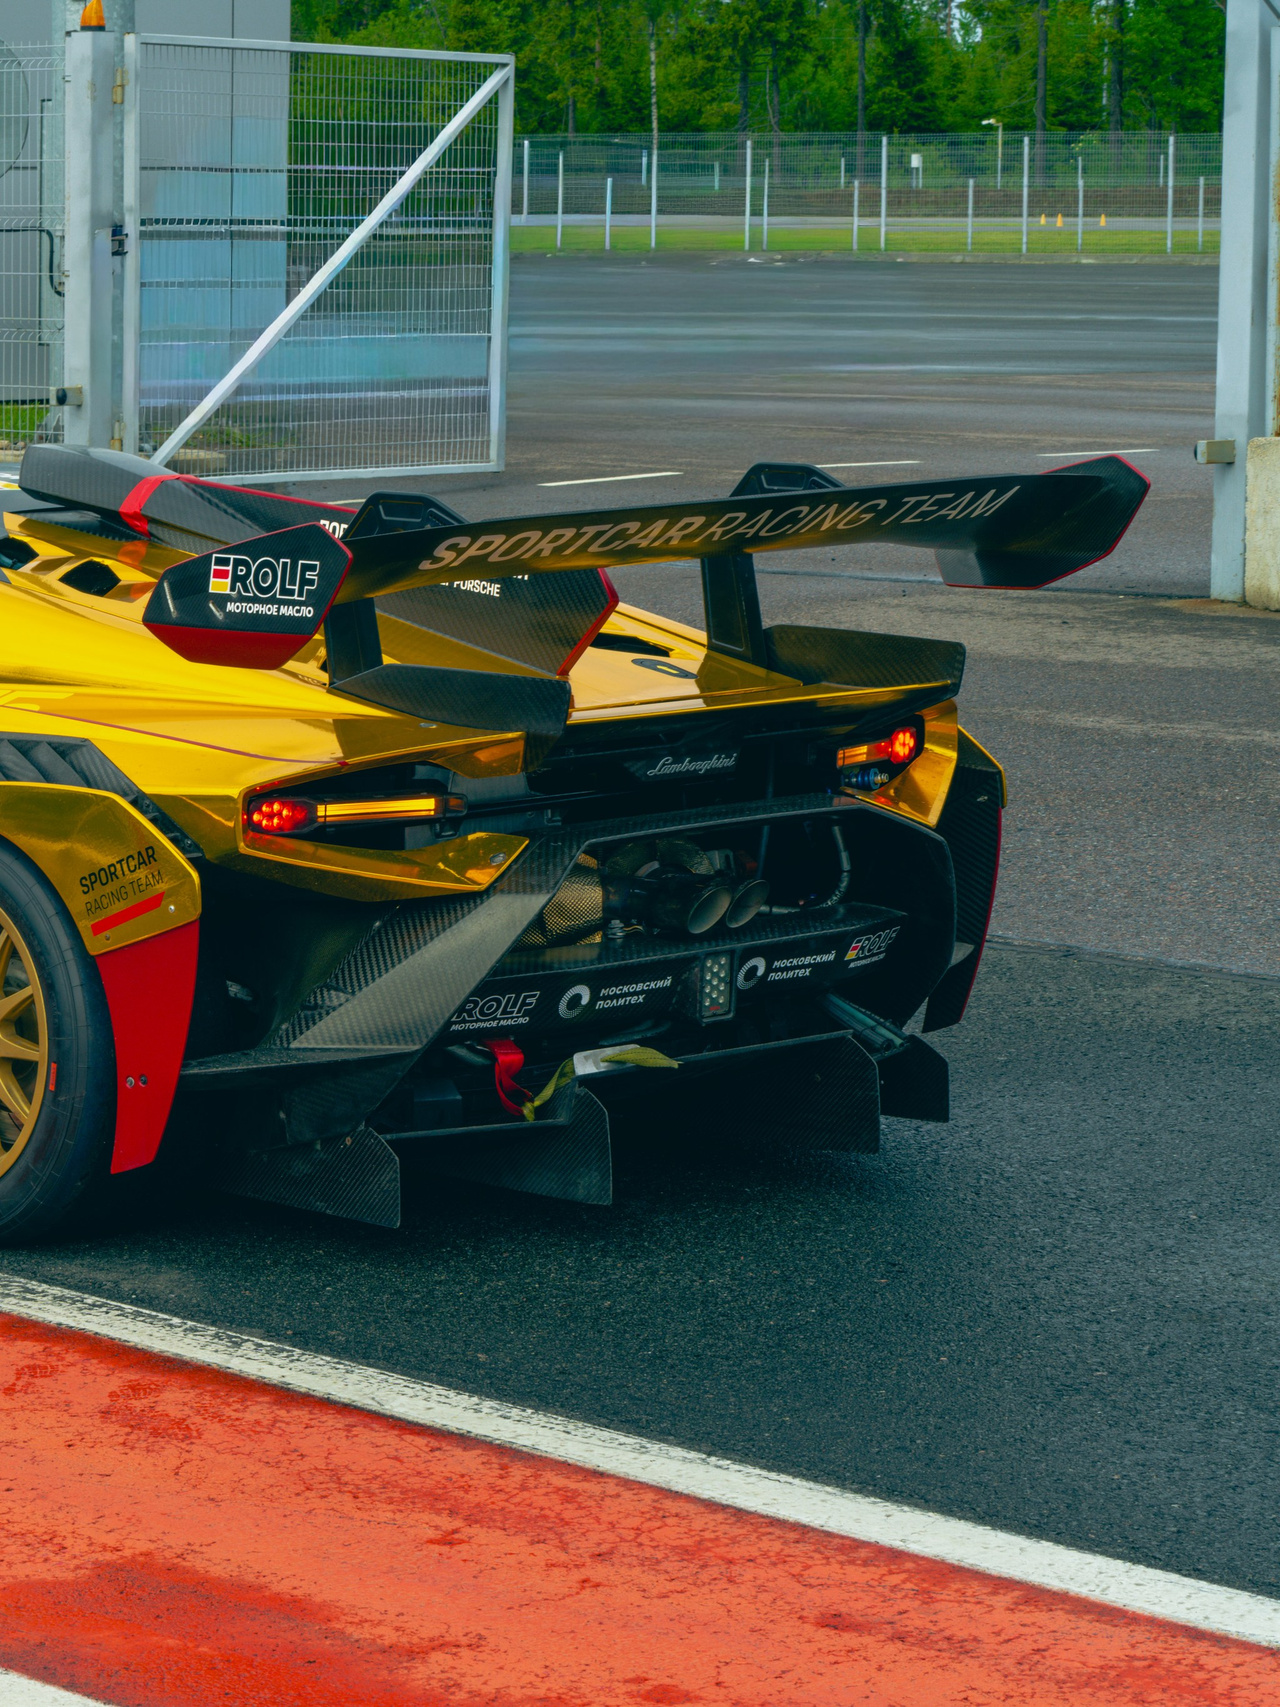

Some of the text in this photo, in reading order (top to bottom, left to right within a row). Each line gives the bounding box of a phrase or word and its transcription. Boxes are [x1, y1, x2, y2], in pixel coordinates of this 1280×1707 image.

[418, 485, 1021, 570] SPORTCAR RACING TEAM
[228, 555, 320, 600] ROLF
[225, 602, 314, 617] МОТОРНОЕ МАСЛО
[646, 752, 737, 776] Lamborghini
[79, 846, 157, 895] SPORTCAR
[85, 870, 164, 916] RACING TEAM
[450, 991, 540, 1021] ROLF
[450, 1016, 530, 1031] МОТОРНОЕ МАСЛО
